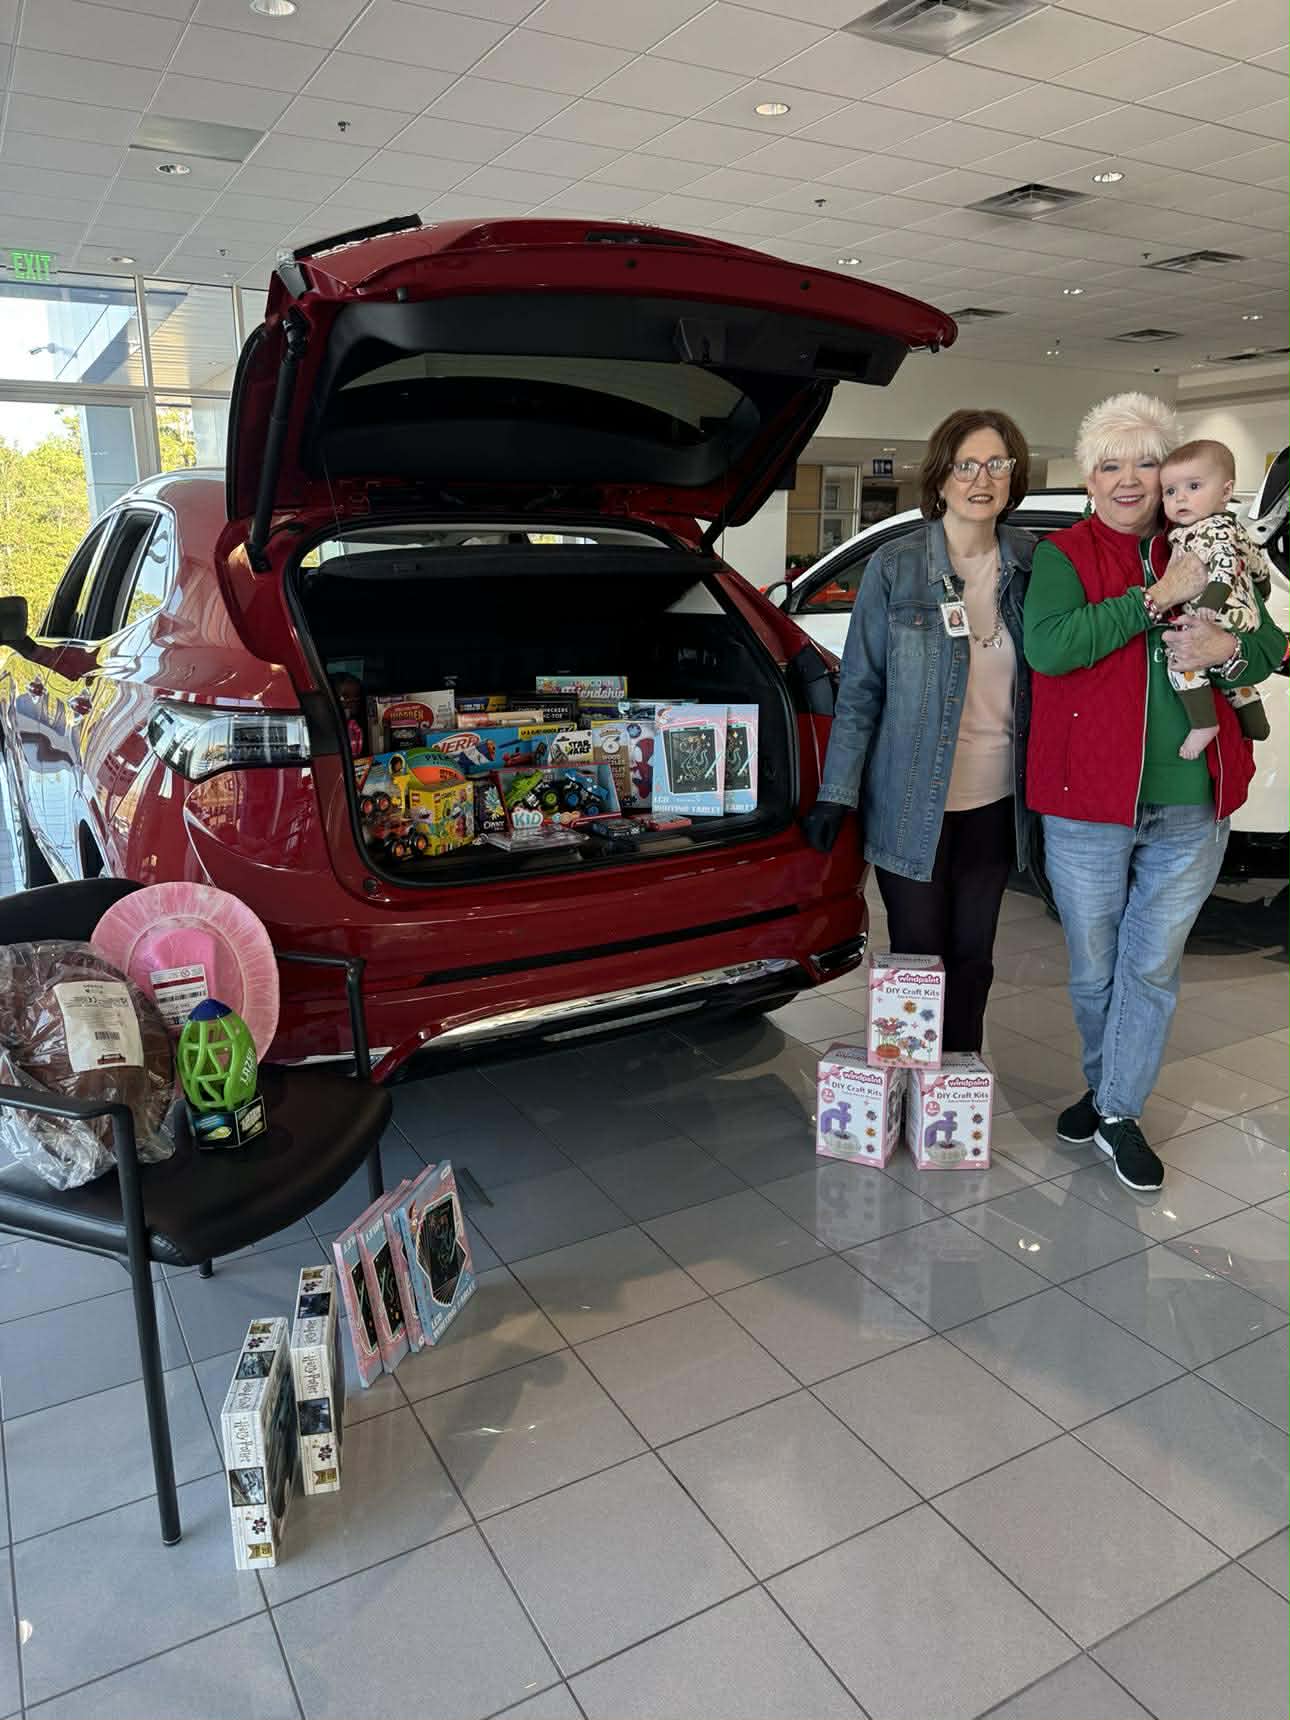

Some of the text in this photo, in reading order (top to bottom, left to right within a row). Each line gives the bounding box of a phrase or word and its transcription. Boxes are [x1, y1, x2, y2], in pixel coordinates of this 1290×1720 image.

[11, 252, 50, 280] EXIT
[436, 735, 480, 753] NERF
[568, 740, 591, 751] STAR
[567, 749, 591, 759] WARS
[514, 812, 542, 827] KID
[902, 988, 922, 996] Craft
[832, 1081, 845, 1089] DIY
[847, 1084, 866, 1093] Craft
[867, 1088, 882, 1097] Kits
[303, 1355, 321, 1394] Harry Potter
[233, 1419, 253, 1463] Harry Potter
